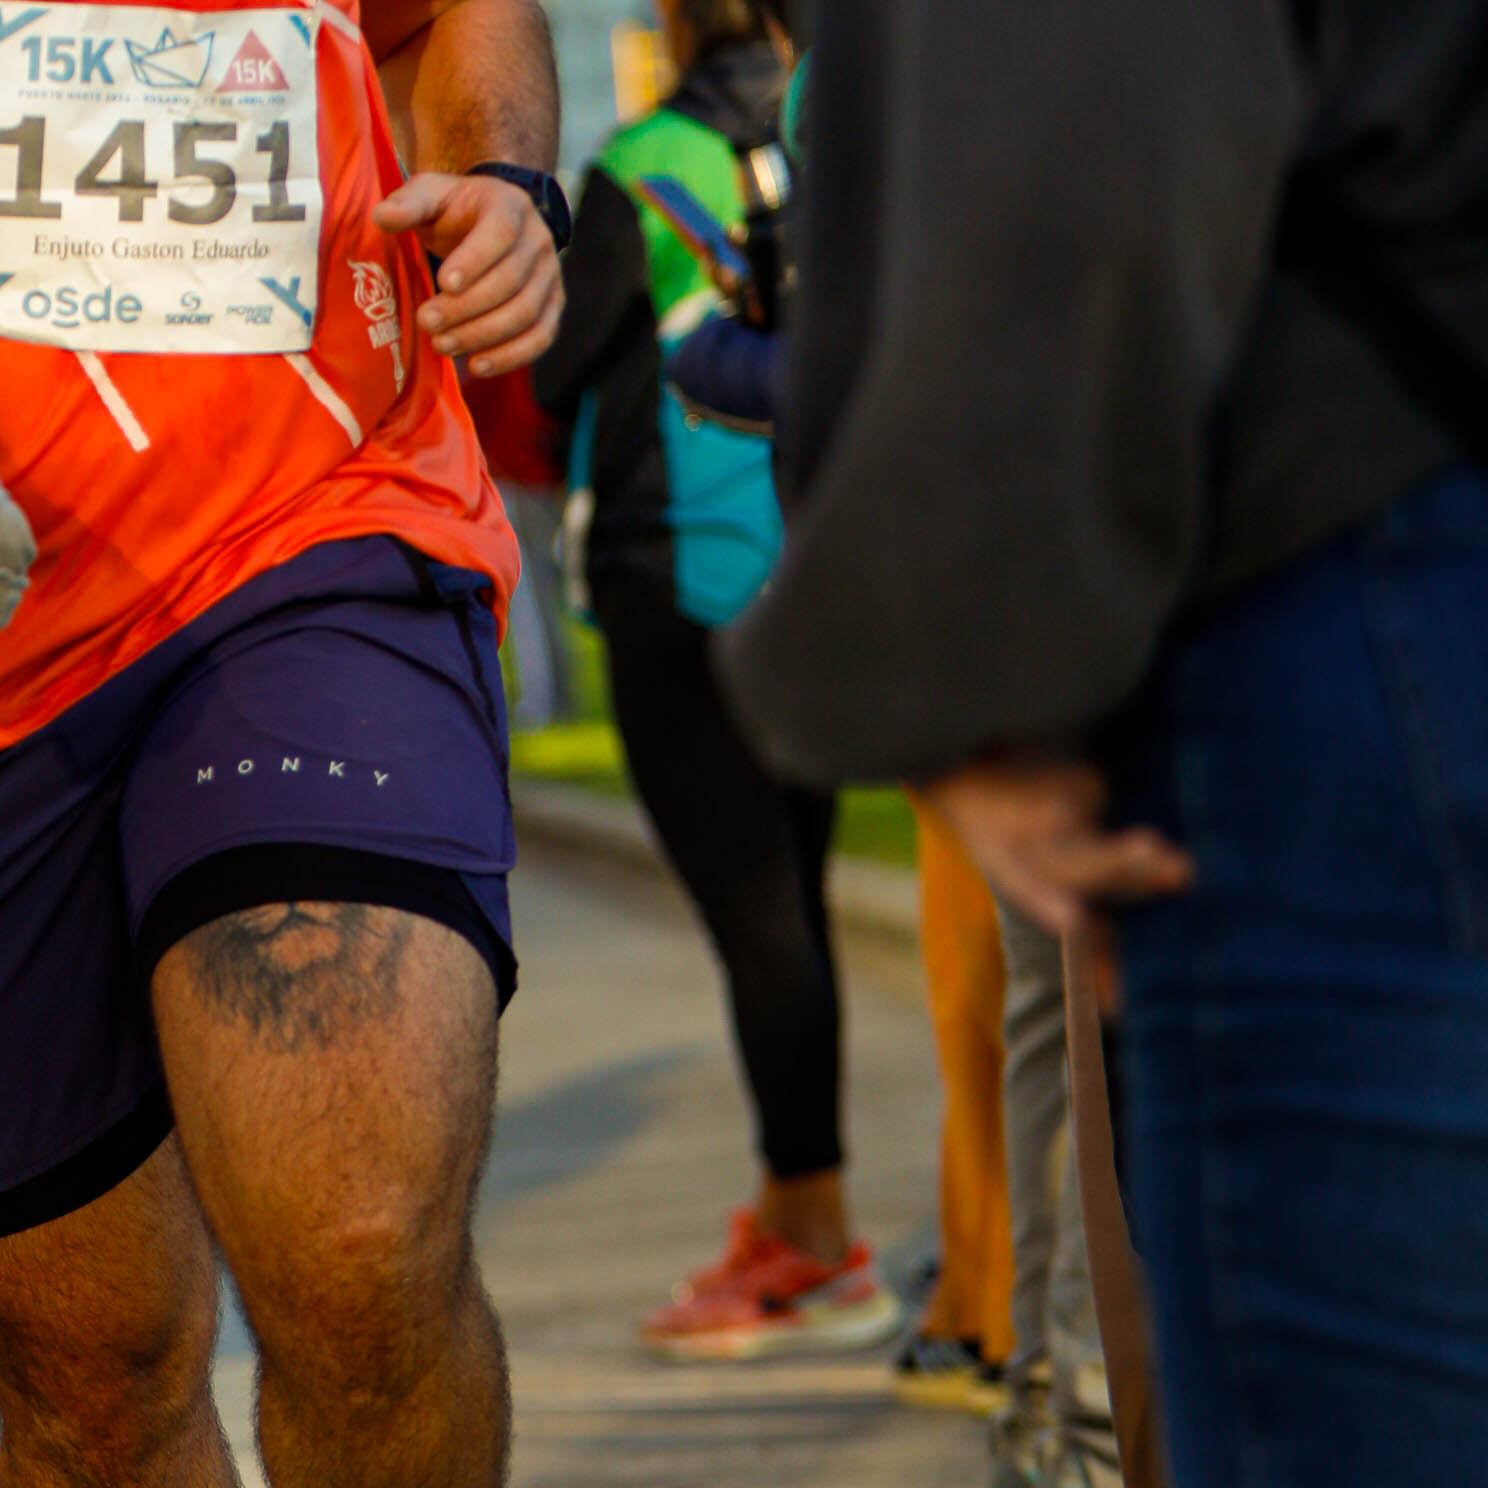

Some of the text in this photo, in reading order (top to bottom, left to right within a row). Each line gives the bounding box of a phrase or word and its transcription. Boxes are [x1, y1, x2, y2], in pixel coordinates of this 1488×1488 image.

[20, 35, 115, 84] 15K
[231, 58, 278, 85] 15K
[33, 235, 270, 261] Enjuto Gaston Eduardo
[22, 283, 143, 327] osde
[197, 757, 389, 786] MONKY
